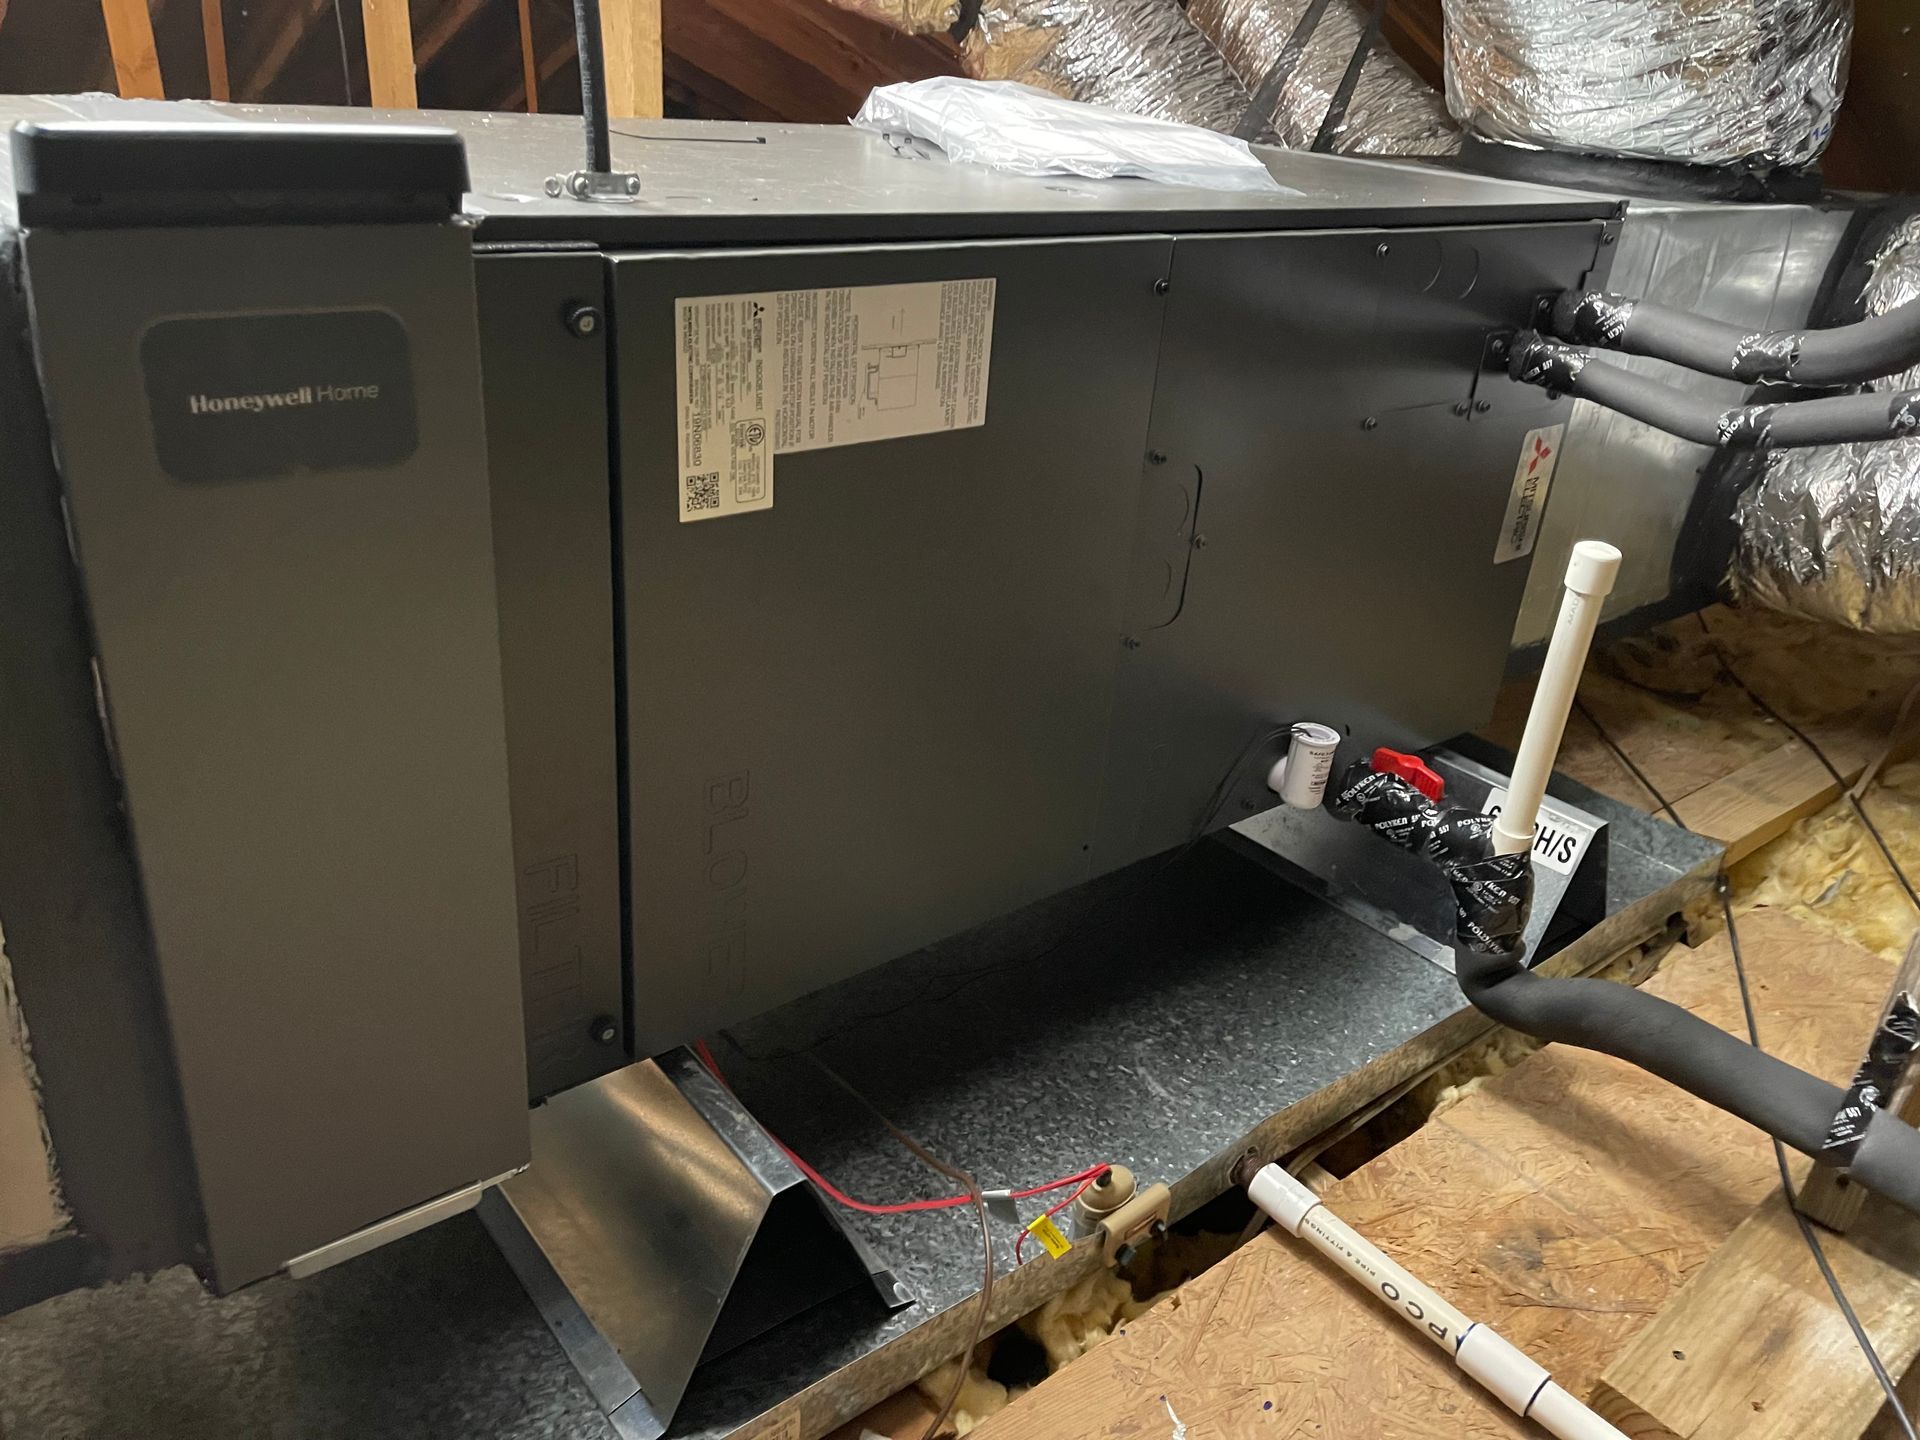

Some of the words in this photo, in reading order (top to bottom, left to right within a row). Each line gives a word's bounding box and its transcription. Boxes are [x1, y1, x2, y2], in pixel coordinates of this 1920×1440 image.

[190, 386, 312, 414] Honeywell
[316, 384, 380, 403] Home
[1510, 478, 1533, 545] ELECTRIC
[1303, 1217, 1344, 1251] FITTINGS
[1354, 1257, 1376, 1276] PIPE
[1381, 1282, 1459, 1347] PCO
